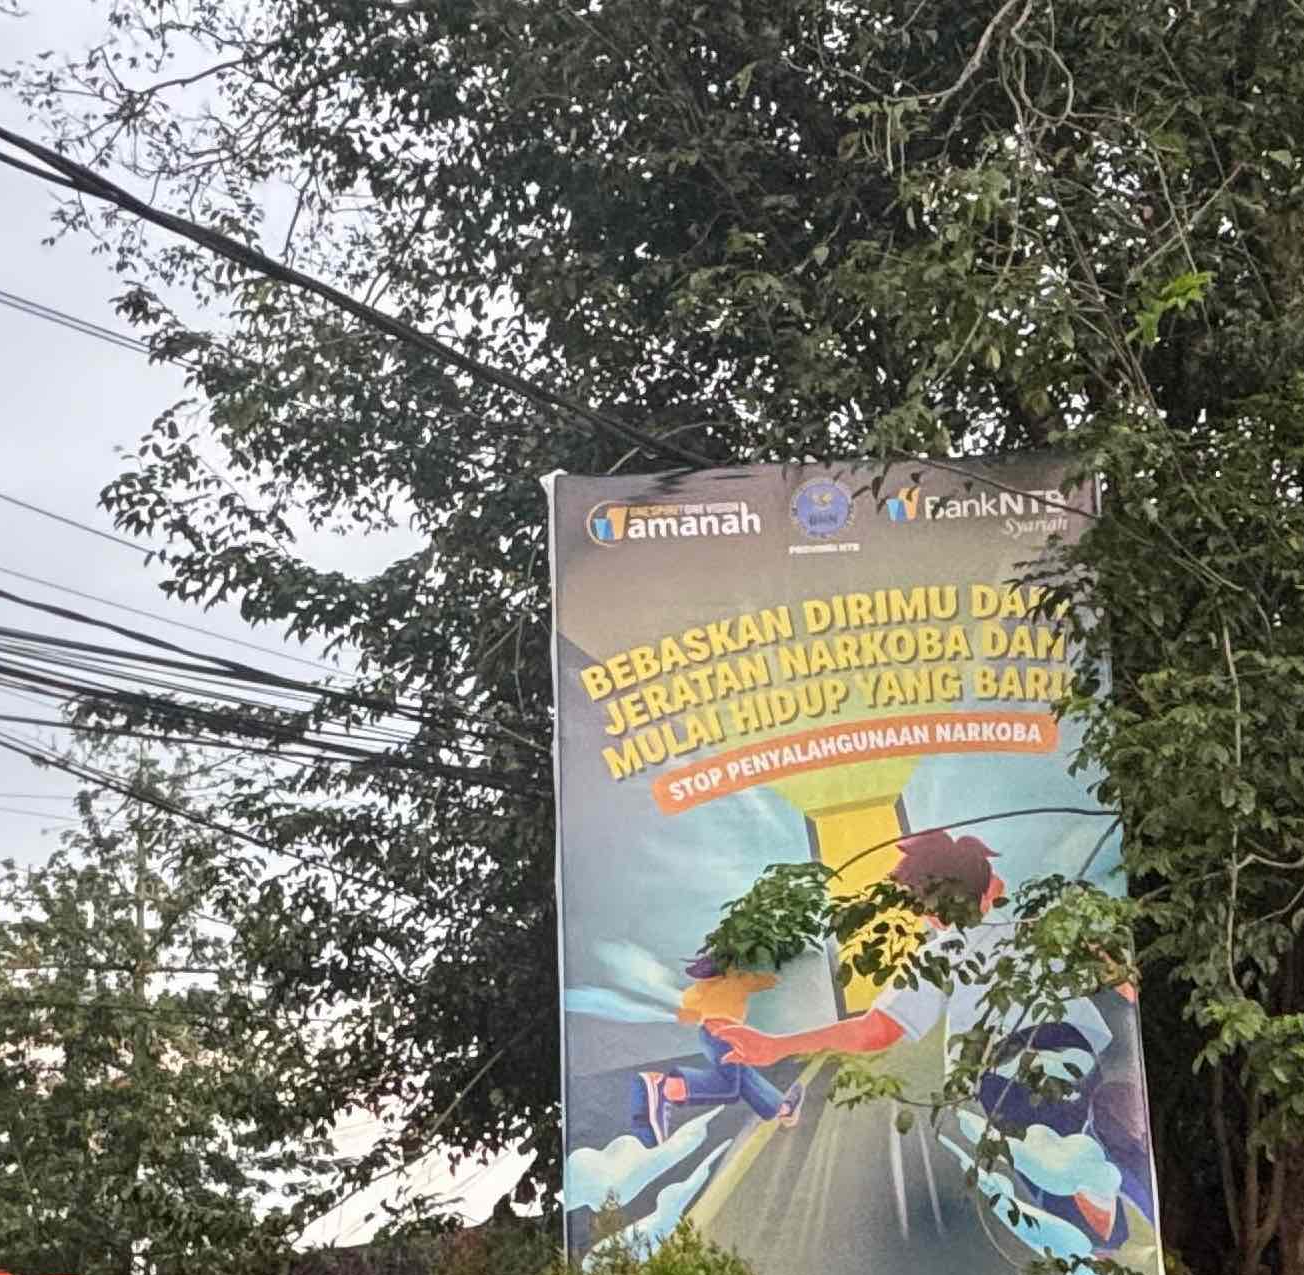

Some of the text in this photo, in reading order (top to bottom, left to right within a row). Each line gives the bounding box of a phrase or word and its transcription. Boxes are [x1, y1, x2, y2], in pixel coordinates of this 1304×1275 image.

[628, 502, 761, 539] amanah
[581, 606, 793, 700] BEBASKAN
[803, 585, 958, 634] DIRIMU
[605, 651, 771, 736] JERATAN
[779, 625, 972, 679] NARKOBA
[602, 707, 725, 779] MULAI
[730, 679, 848, 735] HIDUP
[854, 666, 963, 706] YANG
[669, 721, 1043, 802] STOP PENYALAHGUNAAN NARKOBA
